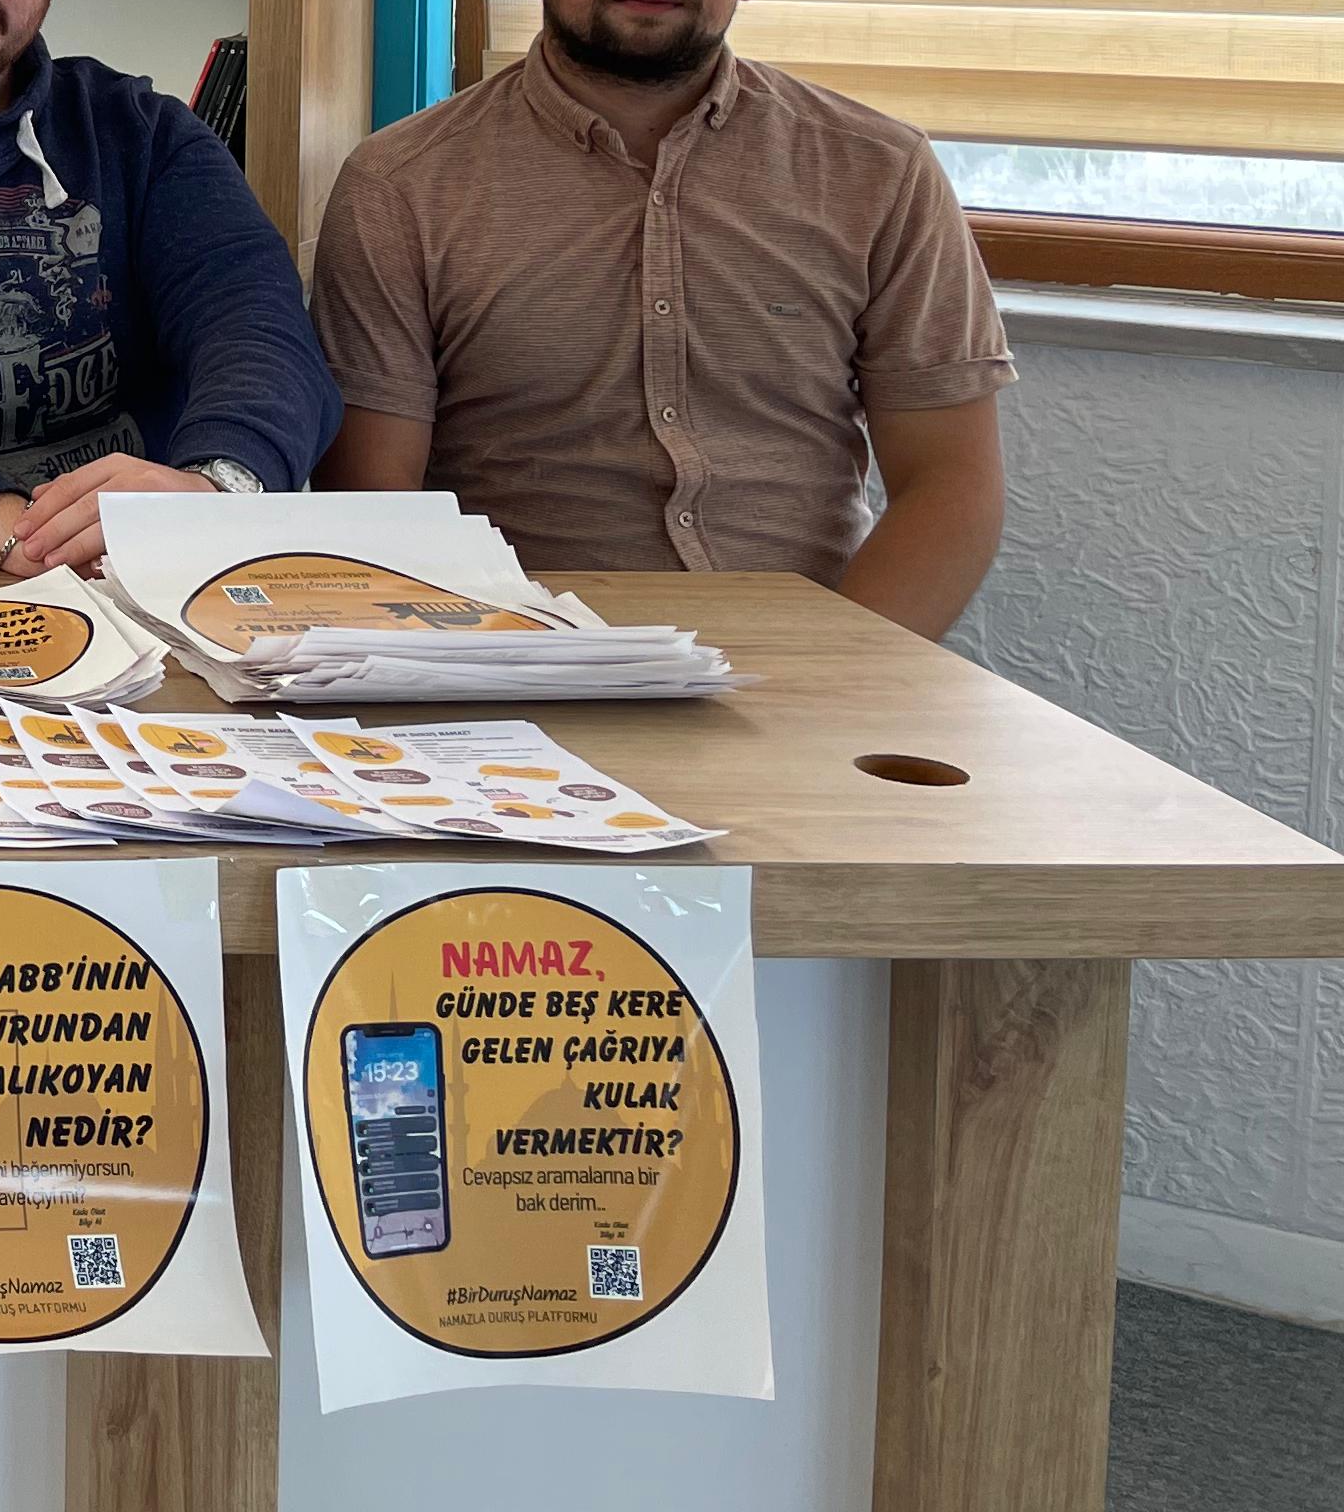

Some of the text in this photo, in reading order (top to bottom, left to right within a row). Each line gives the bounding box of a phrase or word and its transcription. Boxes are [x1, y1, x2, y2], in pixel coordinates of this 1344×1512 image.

[441, 938, 606, 982] NAMAZ,
[435, 986, 685, 1024] GÜNDE BEŞ KERE
[461, 1030, 686, 1071] GELEN ÇAĞRIYA
[363, 1059, 419, 1084] 15:23
[583, 1081, 681, 1112] KULAK
[25, 1107, 154, 1150] NEDİR?
[495, 1122, 685, 1159] VERMEKTİR?
[10, 1159, 135, 1185] beğenmiyorsun,
[461, 1166, 533, 1189] Cevapsız
[638, 1168, 661, 1186] bir
[515, 1192, 607, 1213] bak derim..
[18, 1301, 87, 1317] PLATFORMU
[447, 1286, 577, 1306] #BirDuruşNamaz
[439, 1310, 598, 1328] NAMAZLA DURUŞ PLATFORMU
